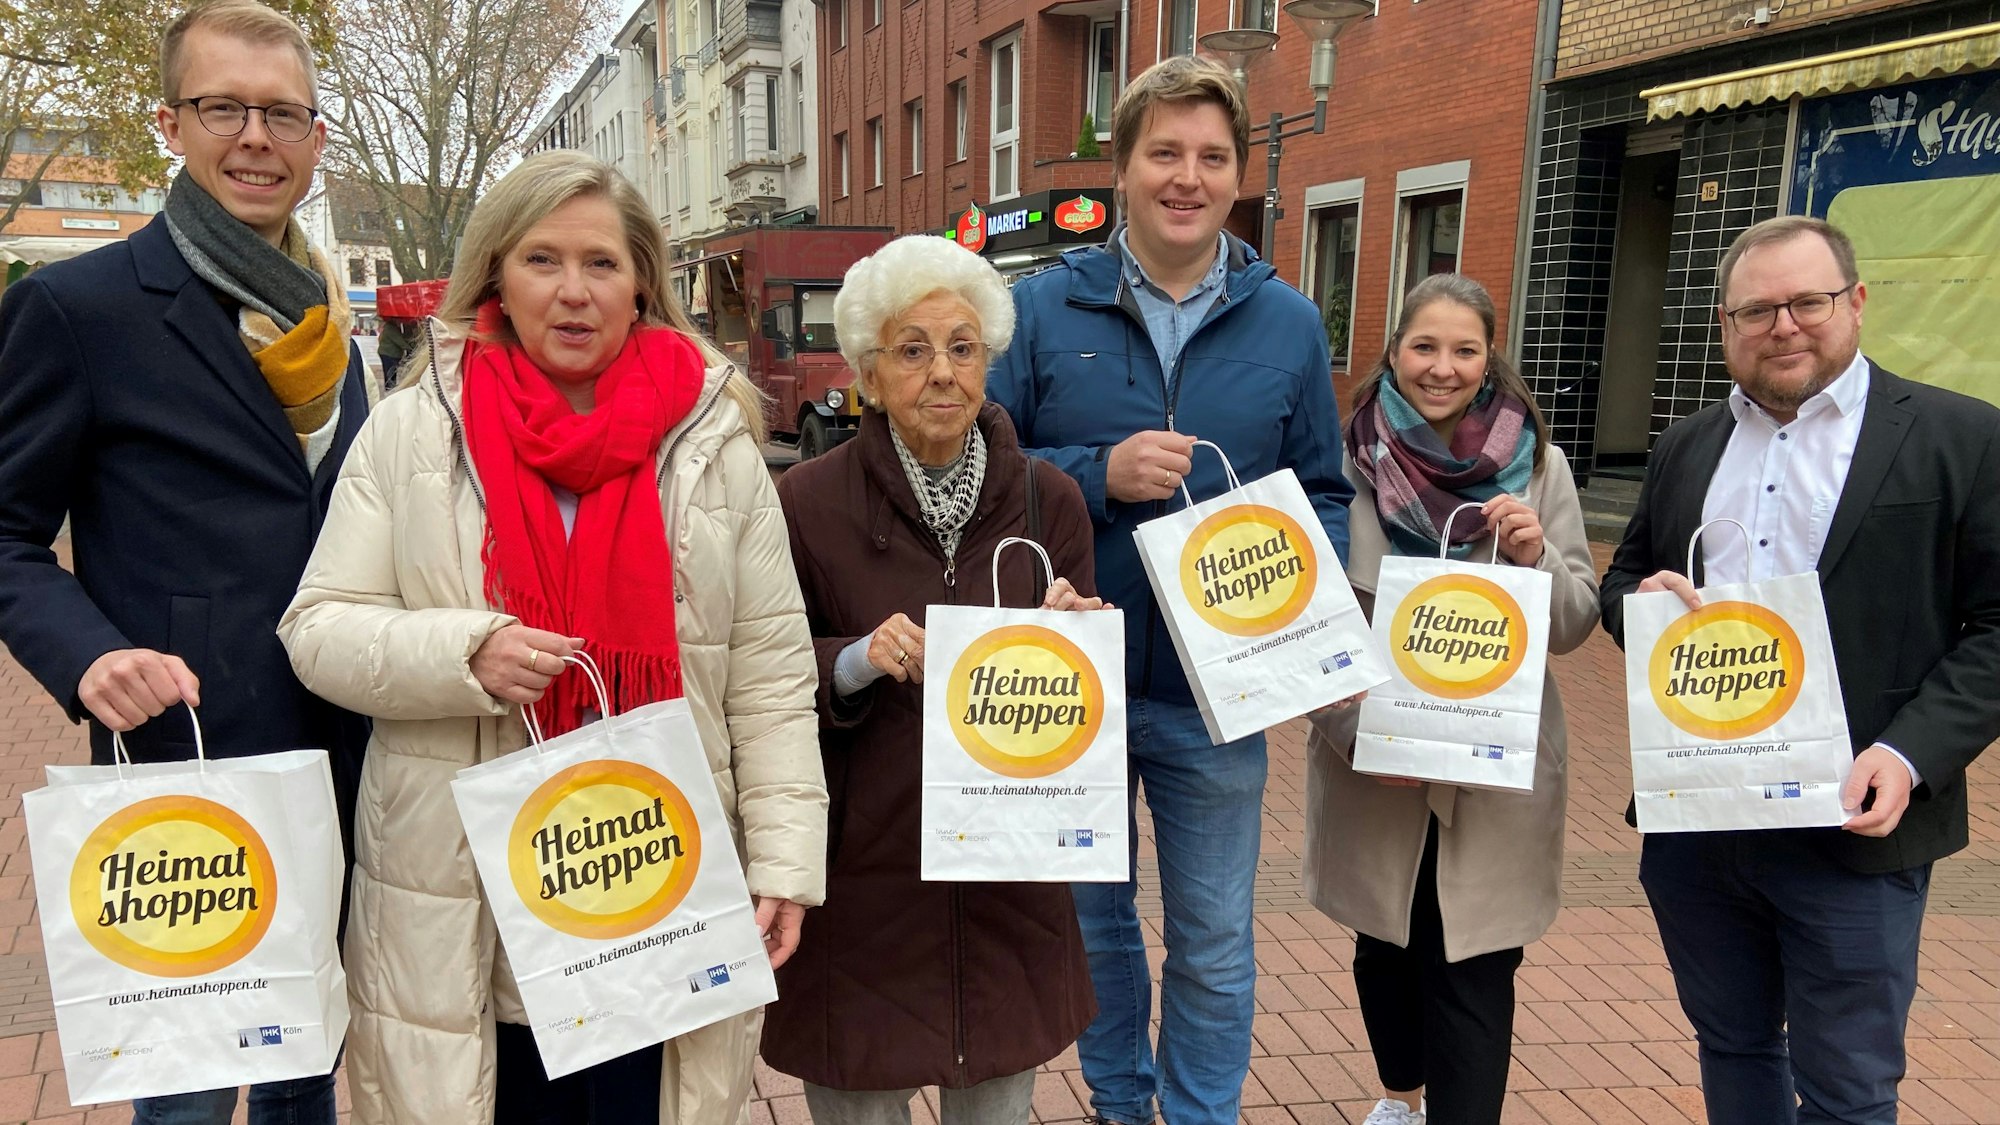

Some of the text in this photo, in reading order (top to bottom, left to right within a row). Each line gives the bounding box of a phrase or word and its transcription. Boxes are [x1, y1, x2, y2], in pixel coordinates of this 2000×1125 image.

[1705, 185, 1716, 198] 16
[987, 209, 1028, 236] MARKET
[1195, 528, 1290, 582] Heimat
[1204, 554, 1305, 608] shoppen
[1412, 605, 1509, 638] Heimat
[1227, 619, 1329, 664] www.heimatshoppen.de
[1402, 631, 1510, 664] shoppen
[1670, 638, 1780, 671] Heimat
[1335, 653, 1348, 662] IHK
[970, 666, 1081, 696] Heimat
[1665, 669, 1787, 702] shoppen
[963, 697, 1086, 734] shoppen
[1394, 699, 1503, 719] www.heimatshoppen.de
[1490, 746, 1502, 754] IHK
[1667, 742, 1791, 759] www.heimatshoppen.de
[961, 785, 1087, 798] www.heimatshoppen.de
[1784, 783, 1799, 791] IHK
[531, 797, 666, 865] Heimat
[1077, 831, 1092, 839] IHK
[99, 846, 248, 890] Heimat
[540, 834, 685, 900] shoppen
[98, 885, 258, 928] shoppen
[564, 921, 707, 977] www.heimatshoppen.de
[709, 961, 747, 978] IHK Köln
[108, 978, 268, 1006] www.heimatshoppen.de
[262, 1027, 302, 1037] IHK Köln
